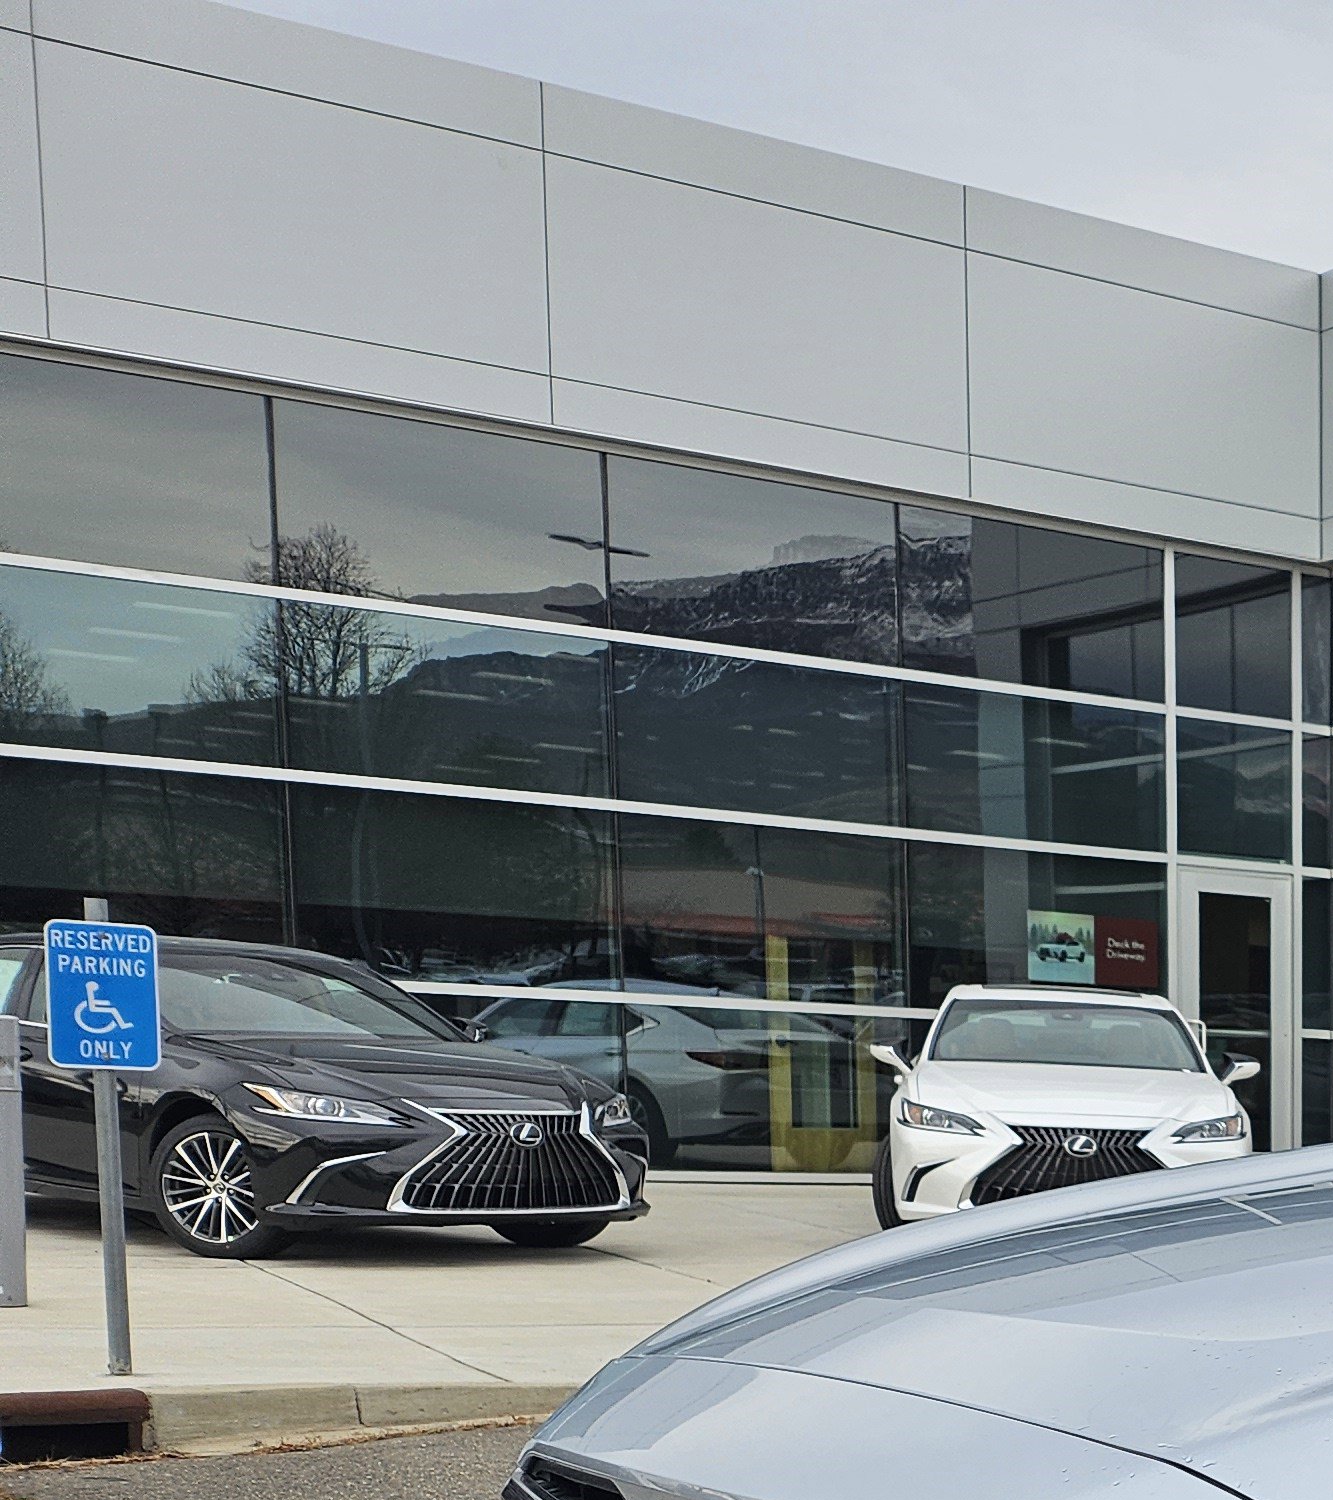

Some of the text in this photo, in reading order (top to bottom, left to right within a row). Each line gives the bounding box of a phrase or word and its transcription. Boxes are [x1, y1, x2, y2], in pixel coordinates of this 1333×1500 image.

[50, 929, 151, 953] RESERVED
[57, 954, 146, 978] PARKING
[79, 1039, 133, 1060] ONLY
